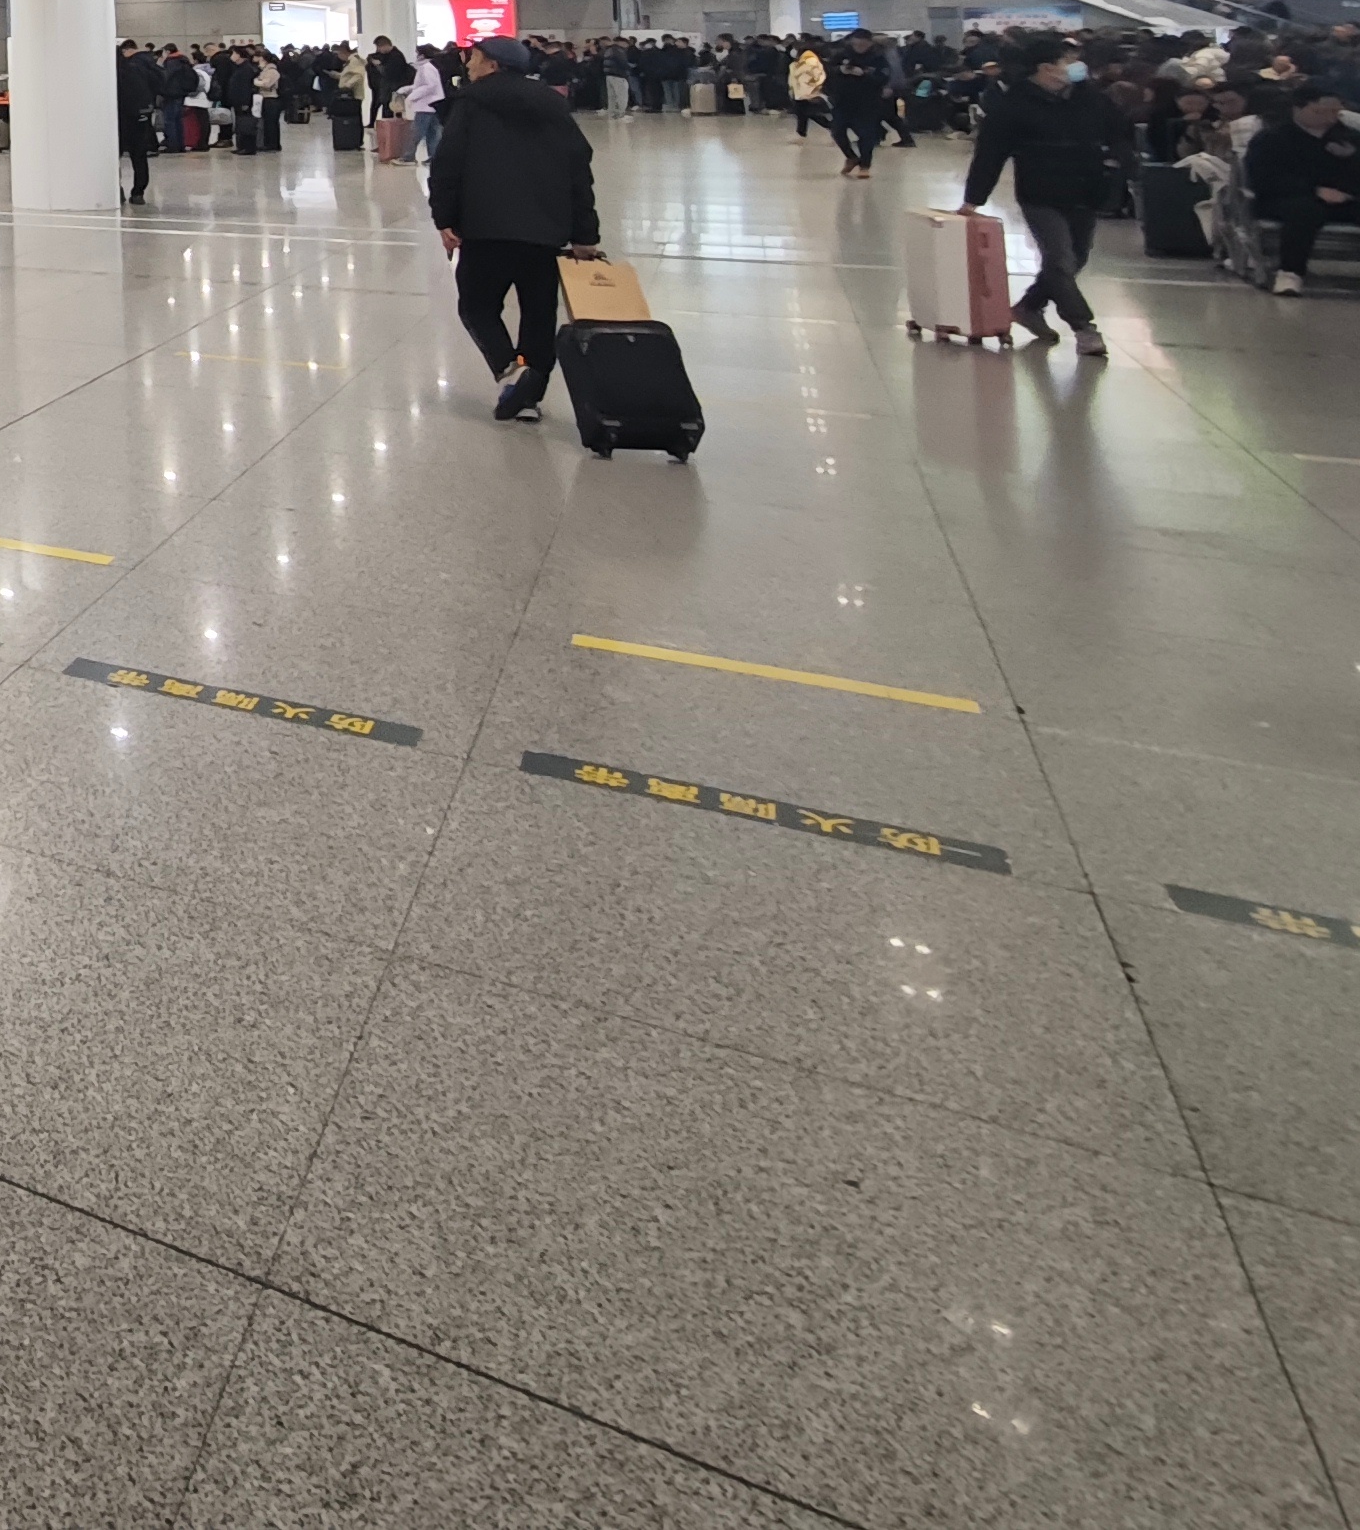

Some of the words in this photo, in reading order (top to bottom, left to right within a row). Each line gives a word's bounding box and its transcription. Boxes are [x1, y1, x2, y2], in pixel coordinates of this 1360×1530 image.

[107, 668, 375, 735] 防火隔离带
[573, 763, 943, 856] 防火隔离带
[1248, 907, 1360, 939] 带
